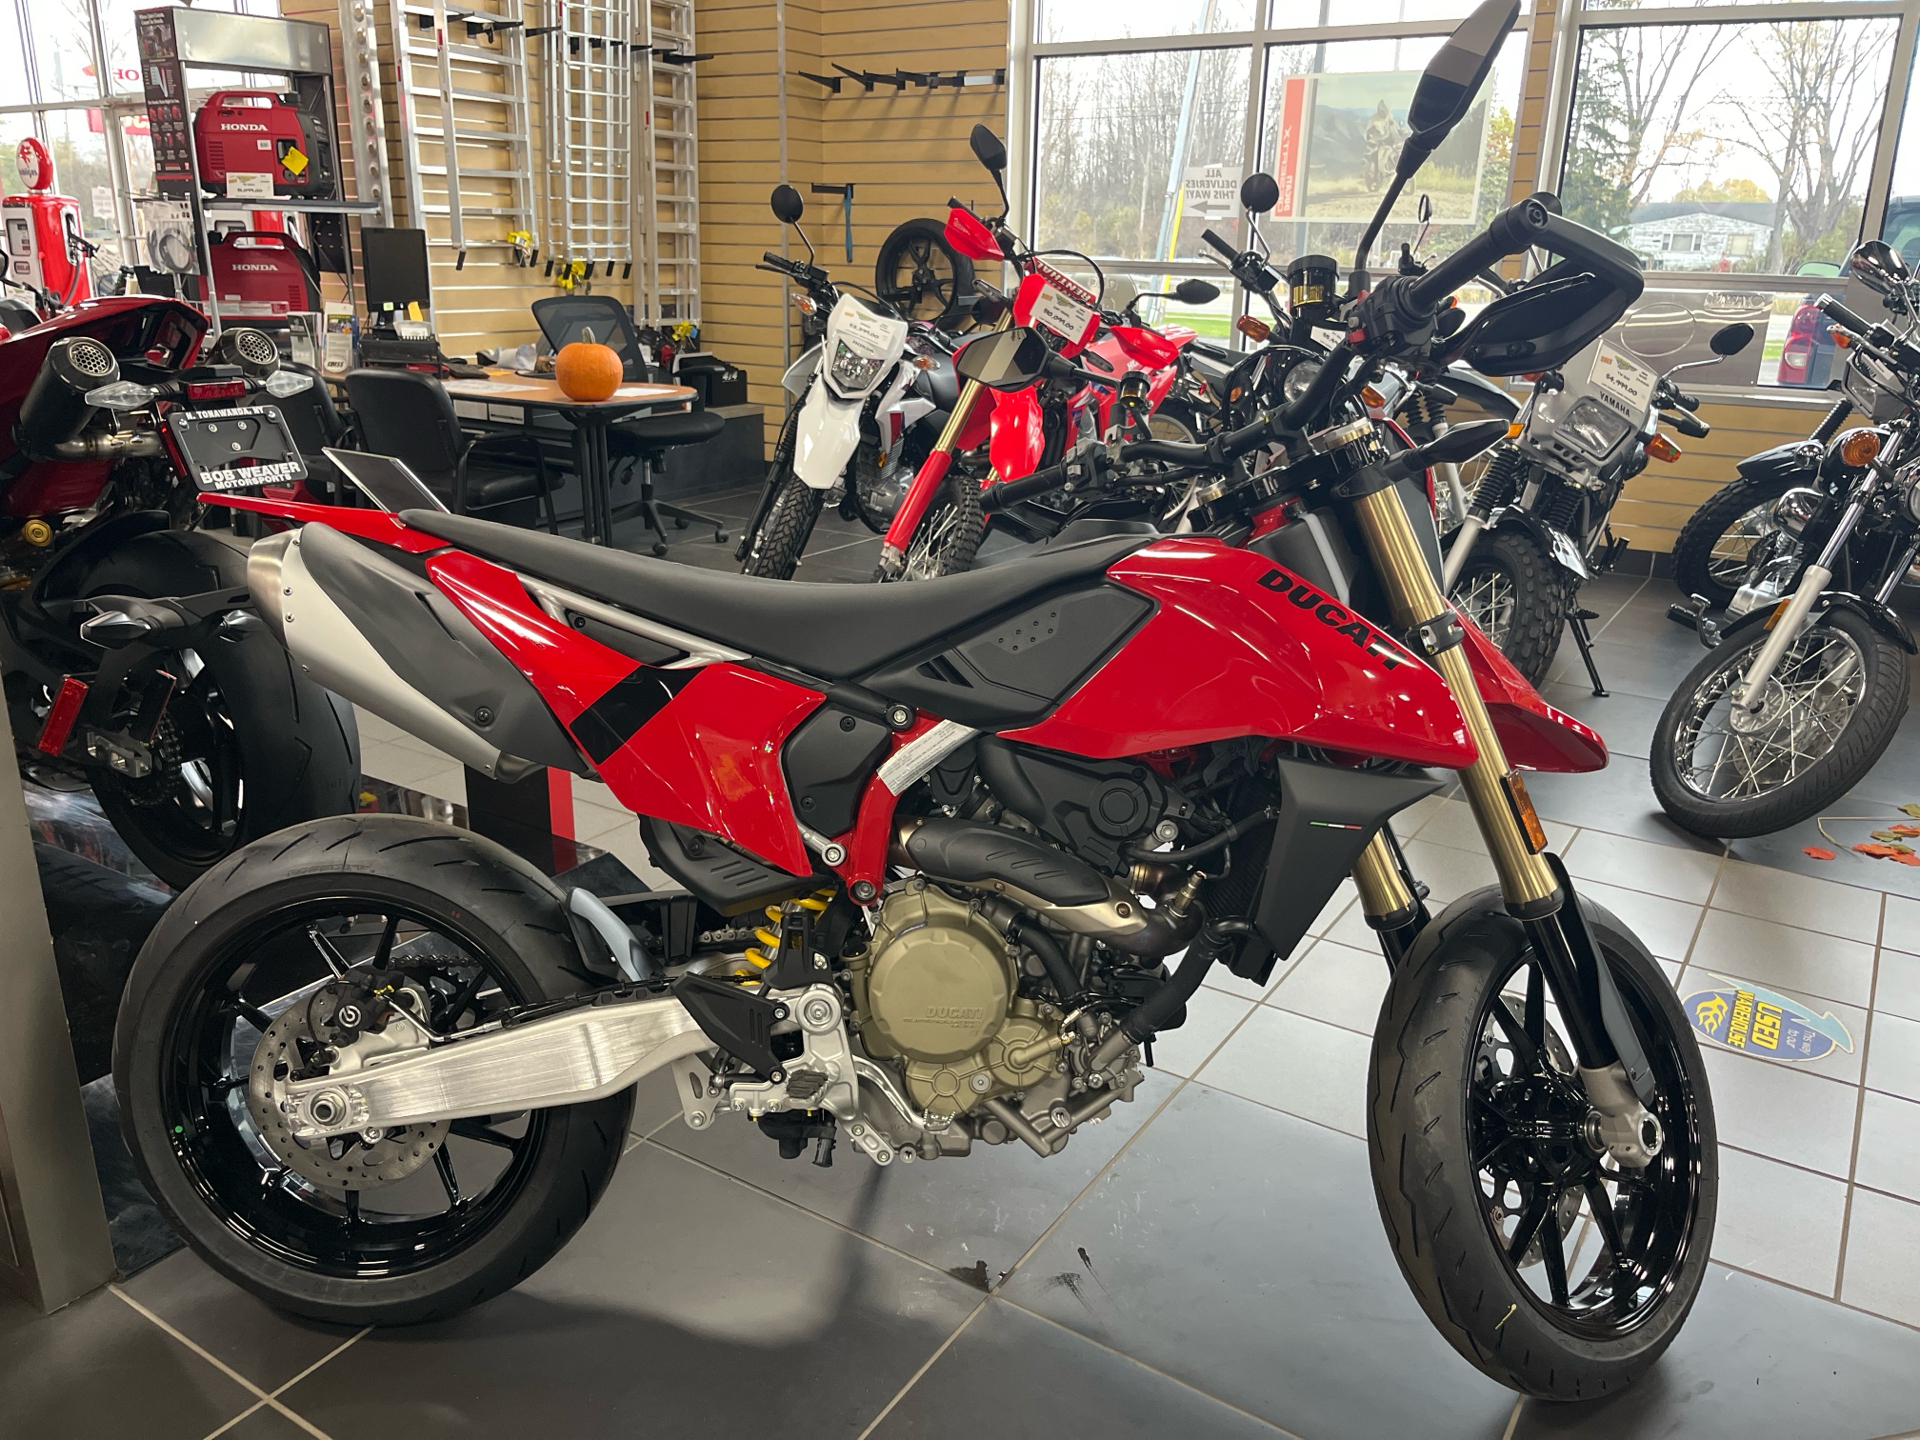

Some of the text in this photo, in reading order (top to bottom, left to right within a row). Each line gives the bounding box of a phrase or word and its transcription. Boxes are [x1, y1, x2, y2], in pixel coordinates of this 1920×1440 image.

[220, 123, 268, 132] HONDA
[1037, 260, 1092, 300] RENTHAL
[185, 411, 196, 420] N.
[253, 406, 265, 415] NY
[1600, 391, 1630, 417] YAMAHA
[200, 461, 301, 484] BOB WEAVER
[215, 474, 292, 490] MOTORSPORTS
[1256, 568, 1408, 671] DUCATI
[926, 1006, 984, 1019] DUCATI
[1726, 989, 1755, 1049] WAREHOUSE
[1751, 1001, 1783, 1050] USED
[1786, 1028, 1799, 1049] to our
[1799, 1030, 1816, 1056] This way
